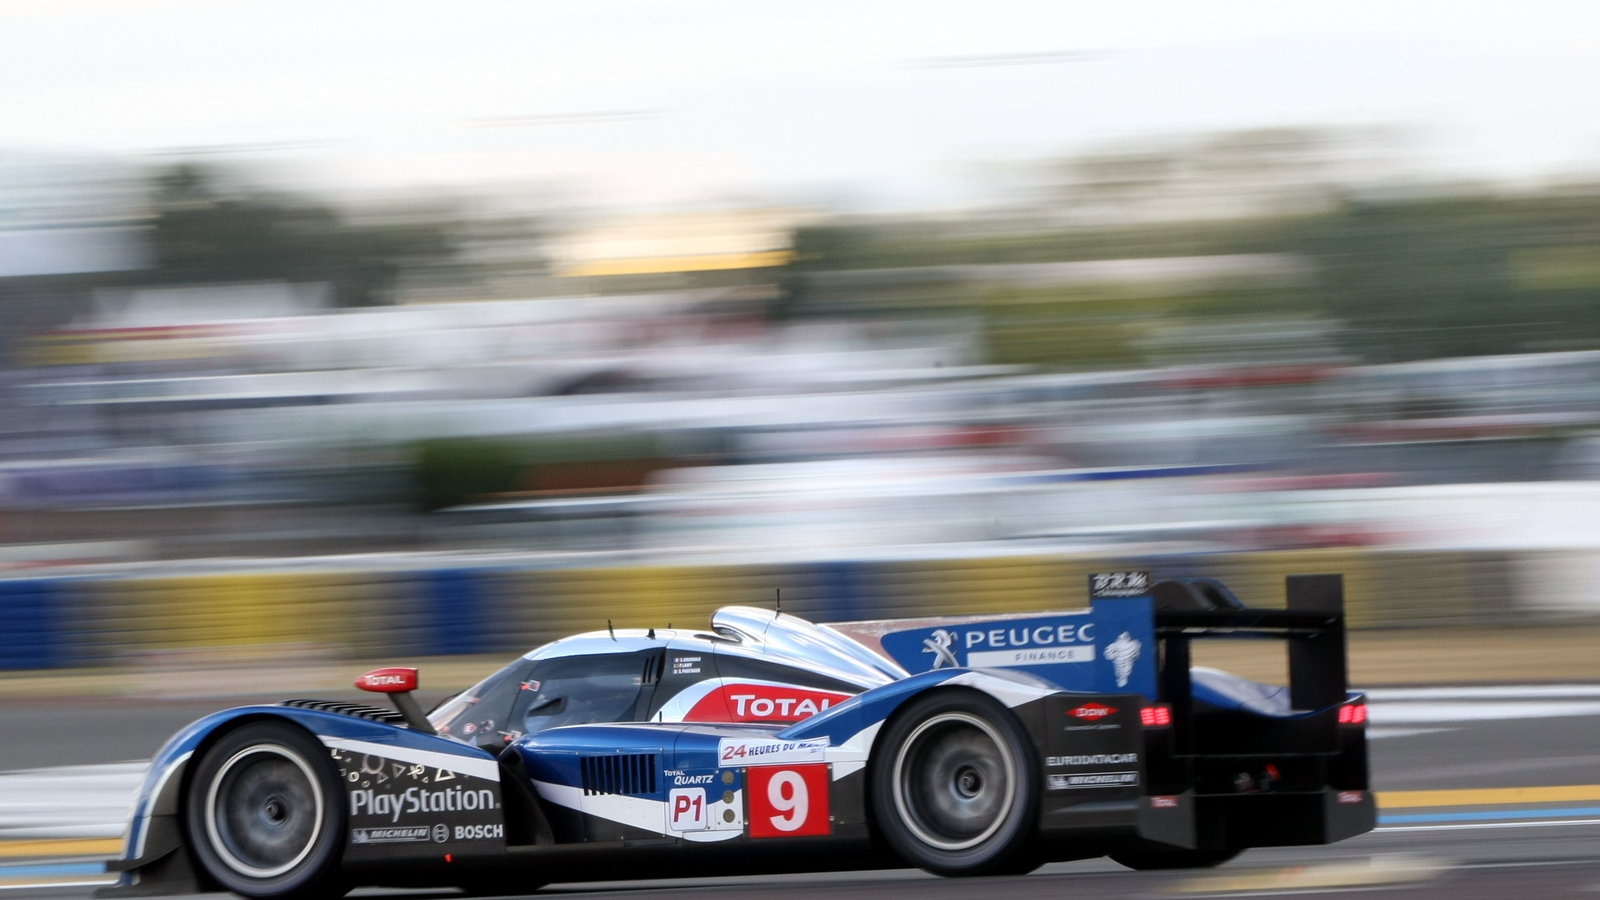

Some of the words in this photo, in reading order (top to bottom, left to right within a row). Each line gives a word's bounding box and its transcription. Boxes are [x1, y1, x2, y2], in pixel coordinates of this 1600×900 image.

[1015, 650, 1075, 661] FINANCE
[365, 674, 406, 686] TOTAL
[722, 744, 747, 760] 24
[748, 744, 781, 756] HEURES
[782, 743, 796, 751] DU
[1046, 753, 1138, 767] EURODATACAR
[674, 775, 714, 785] QUARTZ
[351, 785, 494, 823] PlayStation
[767, 770, 809, 832] 9
[673, 795, 702, 822] P1
[370, 828, 428, 838] MICHELIN
[454, 824, 503, 839] BOSCH
